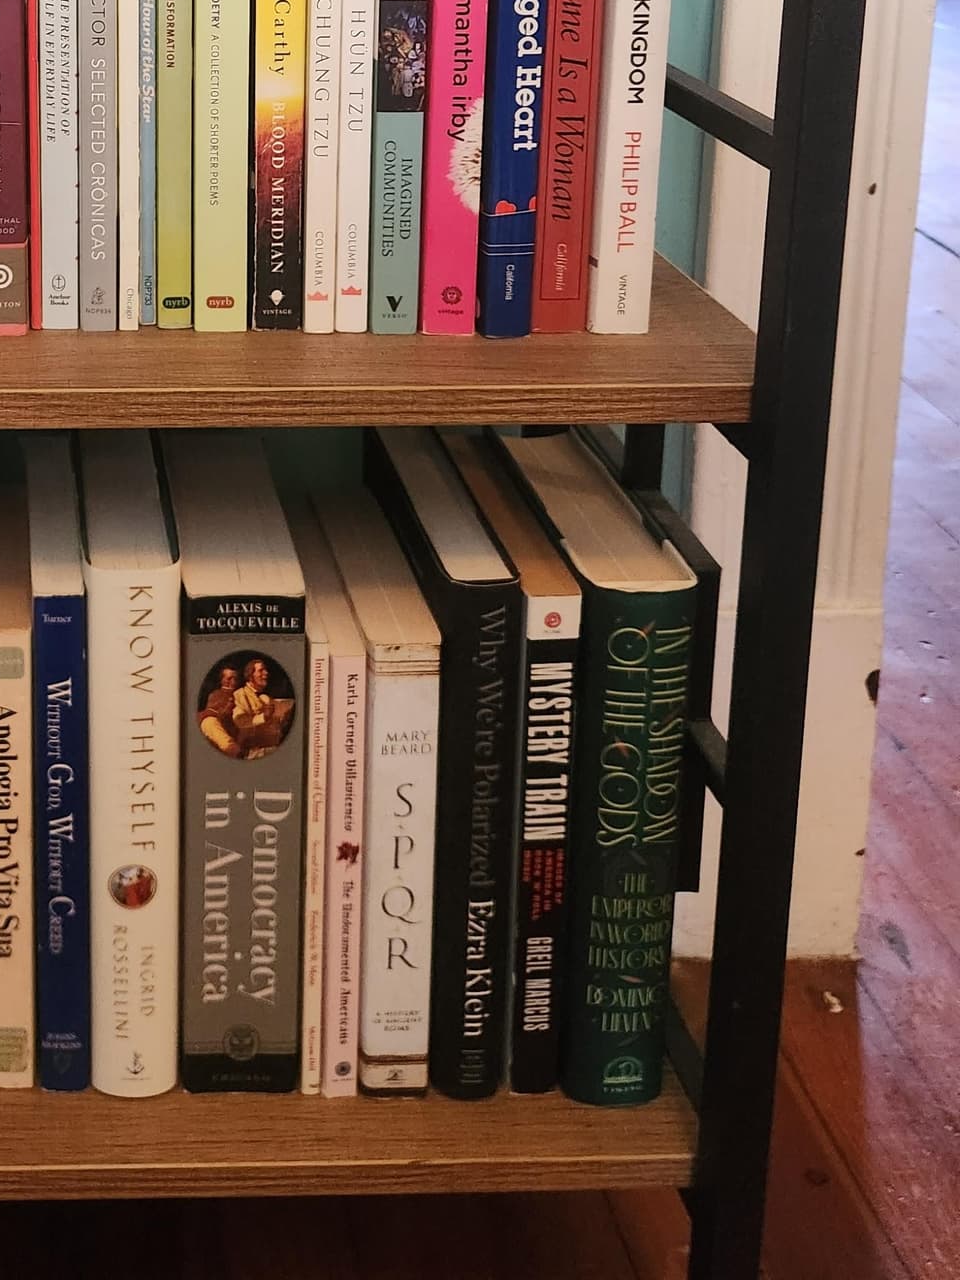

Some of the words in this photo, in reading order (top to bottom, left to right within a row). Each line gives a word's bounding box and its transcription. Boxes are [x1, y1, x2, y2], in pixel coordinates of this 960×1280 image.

[271, 102, 285, 169] BLOOD
[314, 118, 329, 158] TZU
[446, 96, 473, 141] irby
[513, 65, 542, 151] Heart
[621, 131, 642, 197] PHILIP
[271, 177, 285, 273] MERIDIAN
[382, 140, 396, 258] COMMUNITIES
[399, 158, 413, 240] IMAGINED
[617, 202, 637, 253] BALL
[616, 275, 627, 316] VINTAGE
[43, 614, 72, 623] Turner
[129, 586, 154, 694] KNOW
[196, 617, 300, 630] TOCQUEVILLE
[217, 603, 262, 614] ALEXIS
[266, 604, 279, 613] DE
[386, 731, 429, 742] MARY
[527, 662, 573, 763] MYSTERY
[131, 712, 155, 851] THYSELF
[382, 744, 432, 756] BEARD
[524, 774, 568, 840] TRAIN
[238, 791, 293, 1005] Democracy
[466, 900, 495, 960] Ezra
[112, 925, 128, 1039] ROSSELLINI
[526, 937, 554, 972] GREIL
[464, 968, 491, 1037] Klein
[523, 979, 552, 1031] MARCUS
